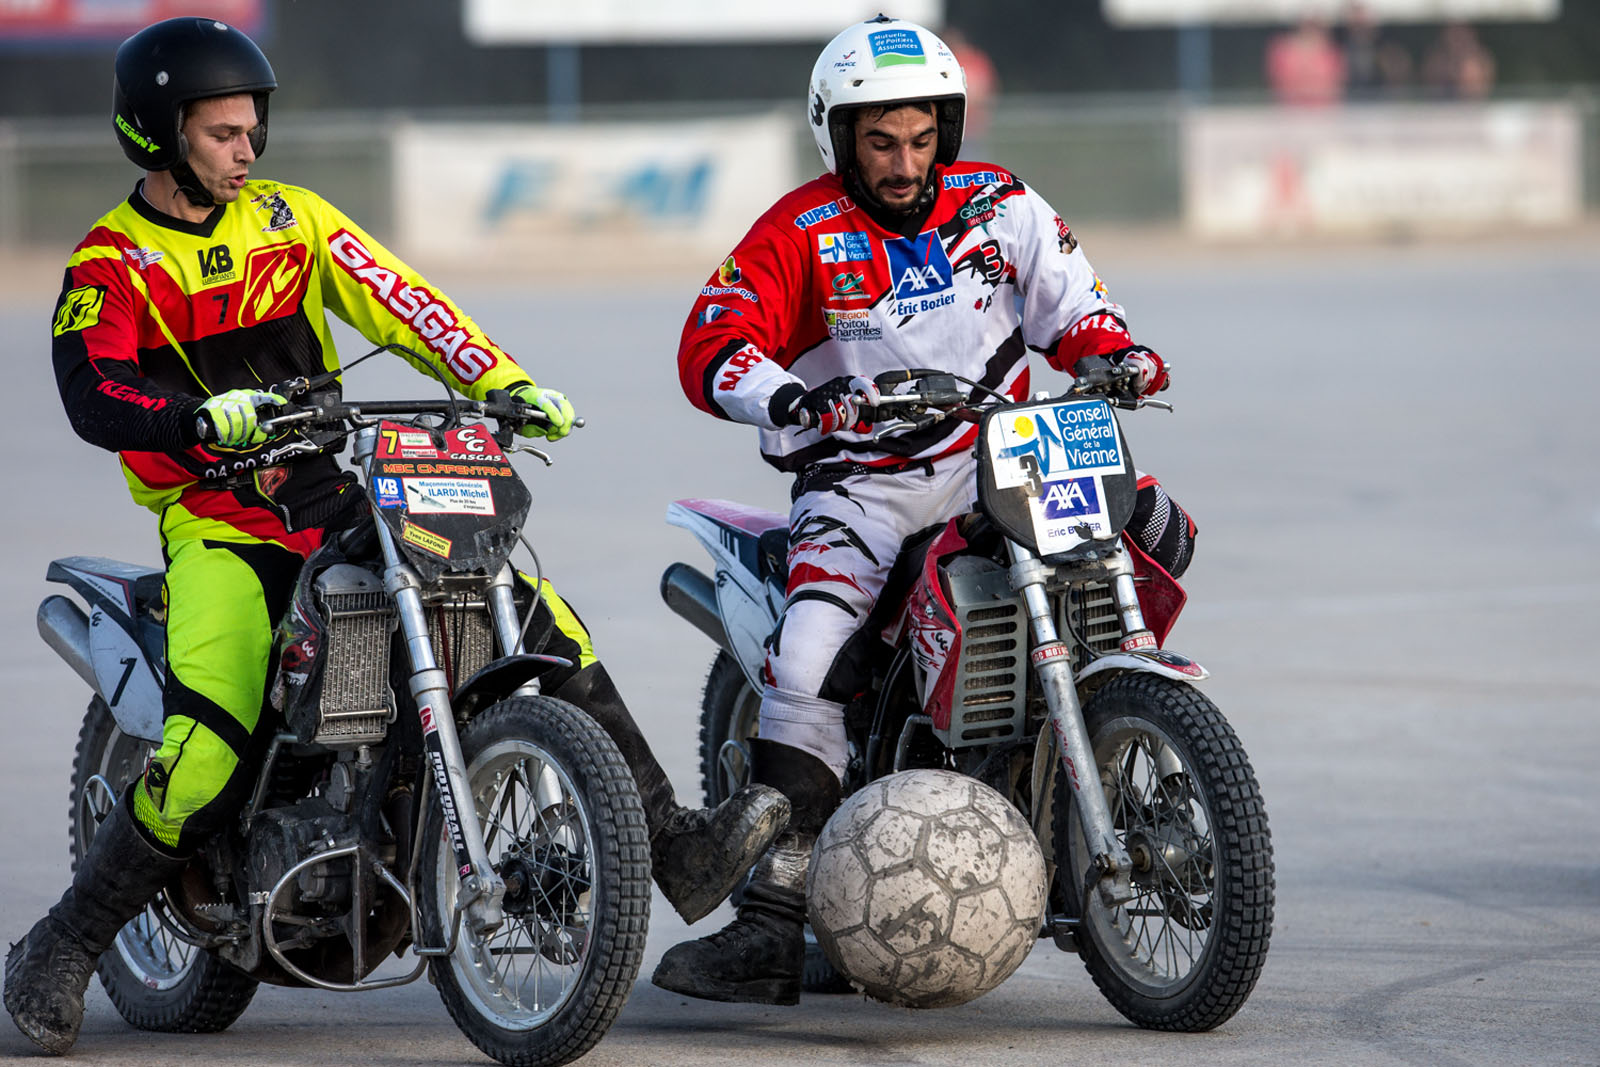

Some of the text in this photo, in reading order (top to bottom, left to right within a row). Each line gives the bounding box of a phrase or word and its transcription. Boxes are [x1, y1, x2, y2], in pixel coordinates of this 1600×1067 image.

[874, 32, 906, 40] Mutuelle
[878, 43, 918, 52] Assurances
[116, 113, 160, 153] KENNY
[943, 171, 1014, 191] SUPER U
[793, 200, 841, 231] SUPER
[979, 239, 1005, 280] 3
[202, 271, 236, 286] LUBRIFIANTS
[895, 264, 946, 294] AXA
[700, 285, 759, 303] uturoscope
[212, 292, 230, 325] 7
[328, 231, 494, 383] GASGAS
[897, 293, 956, 316] Éric Bozier
[836, 311, 869, 320] REGION
[836, 319, 870, 329] Poitou
[829, 326, 881, 337] Charentes
[96, 380, 174, 412] KENNY
[1057, 402, 1110, 425] Conseil
[1062, 422, 1114, 442] Général
[382, 430, 399, 455] 7
[1083, 440, 1100, 449] de la
[450, 453, 503, 462] GASGAS
[1067, 448, 1118, 467] Vienne
[383, 463, 513, 477] MBC CARPENTRAS
[1019, 454, 1044, 498] 3
[418, 480, 483, 489] Maçonnerie Générale
[428, 488, 489, 499] ILARDI Michel
[1041, 481, 1089, 511] AXA
[1047, 526, 1067, 538] Eric
[422, 536, 446, 551] LAFOND
[432, 751, 464, 850] MOTOBALL
